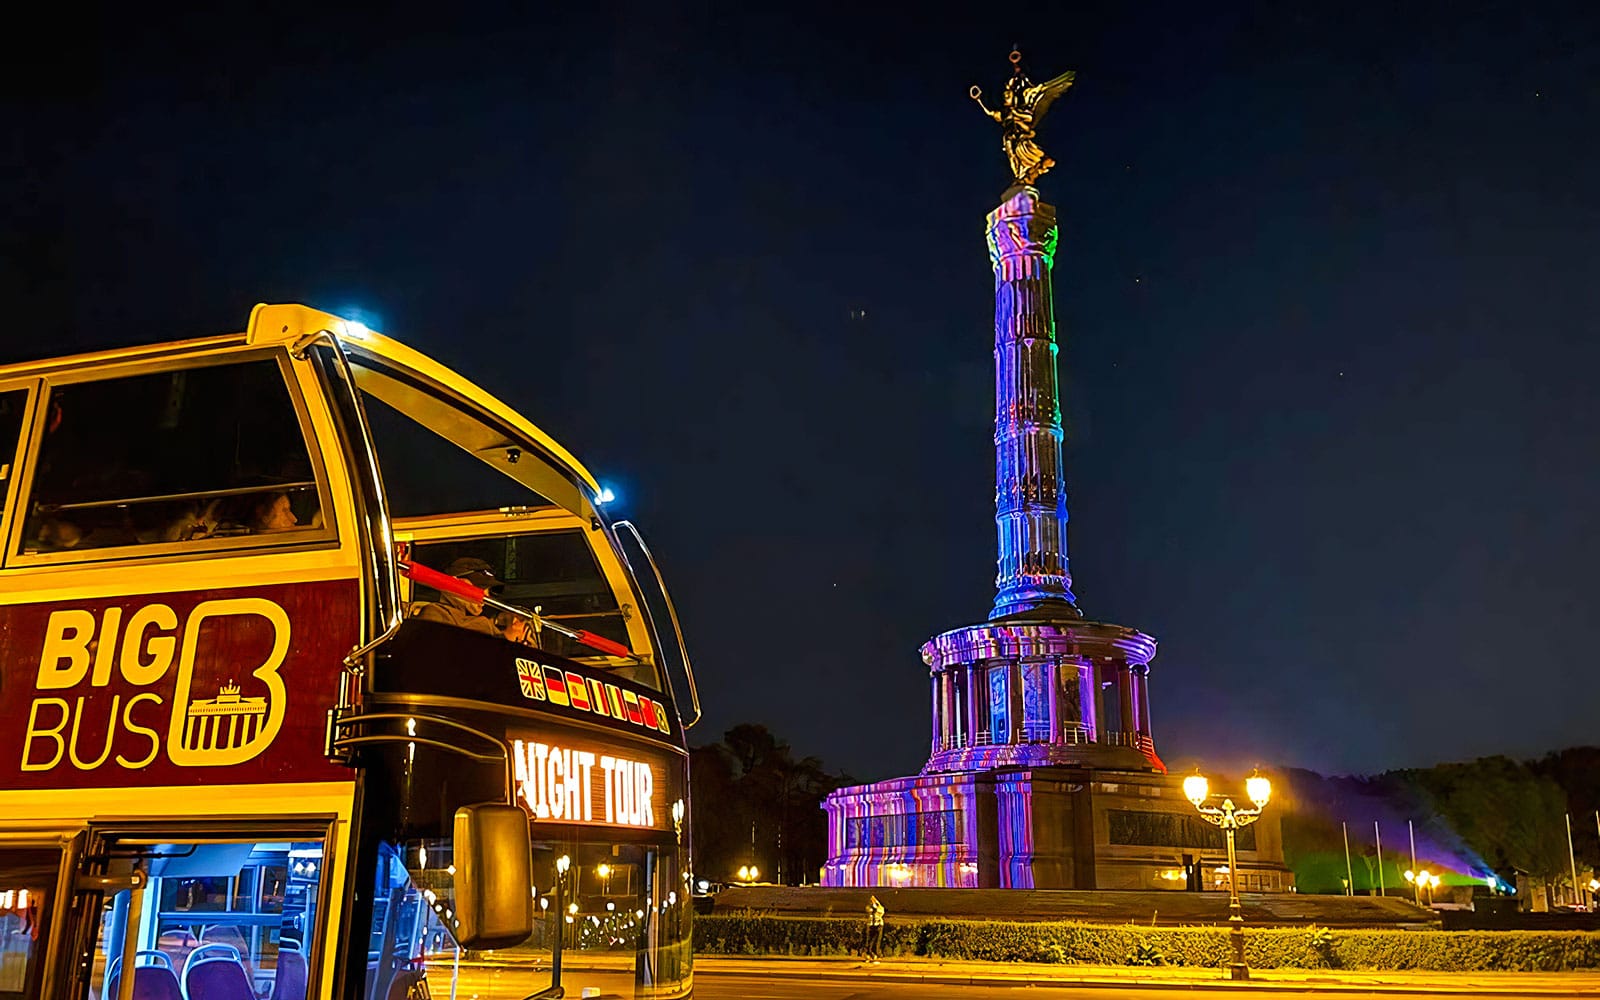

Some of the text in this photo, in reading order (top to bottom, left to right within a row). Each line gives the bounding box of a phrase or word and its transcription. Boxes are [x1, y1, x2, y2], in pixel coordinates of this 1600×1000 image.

[36, 604, 178, 689] BIG
[21, 693, 164, 771] BUS
[514, 739, 654, 827] NIGHT TOUR
